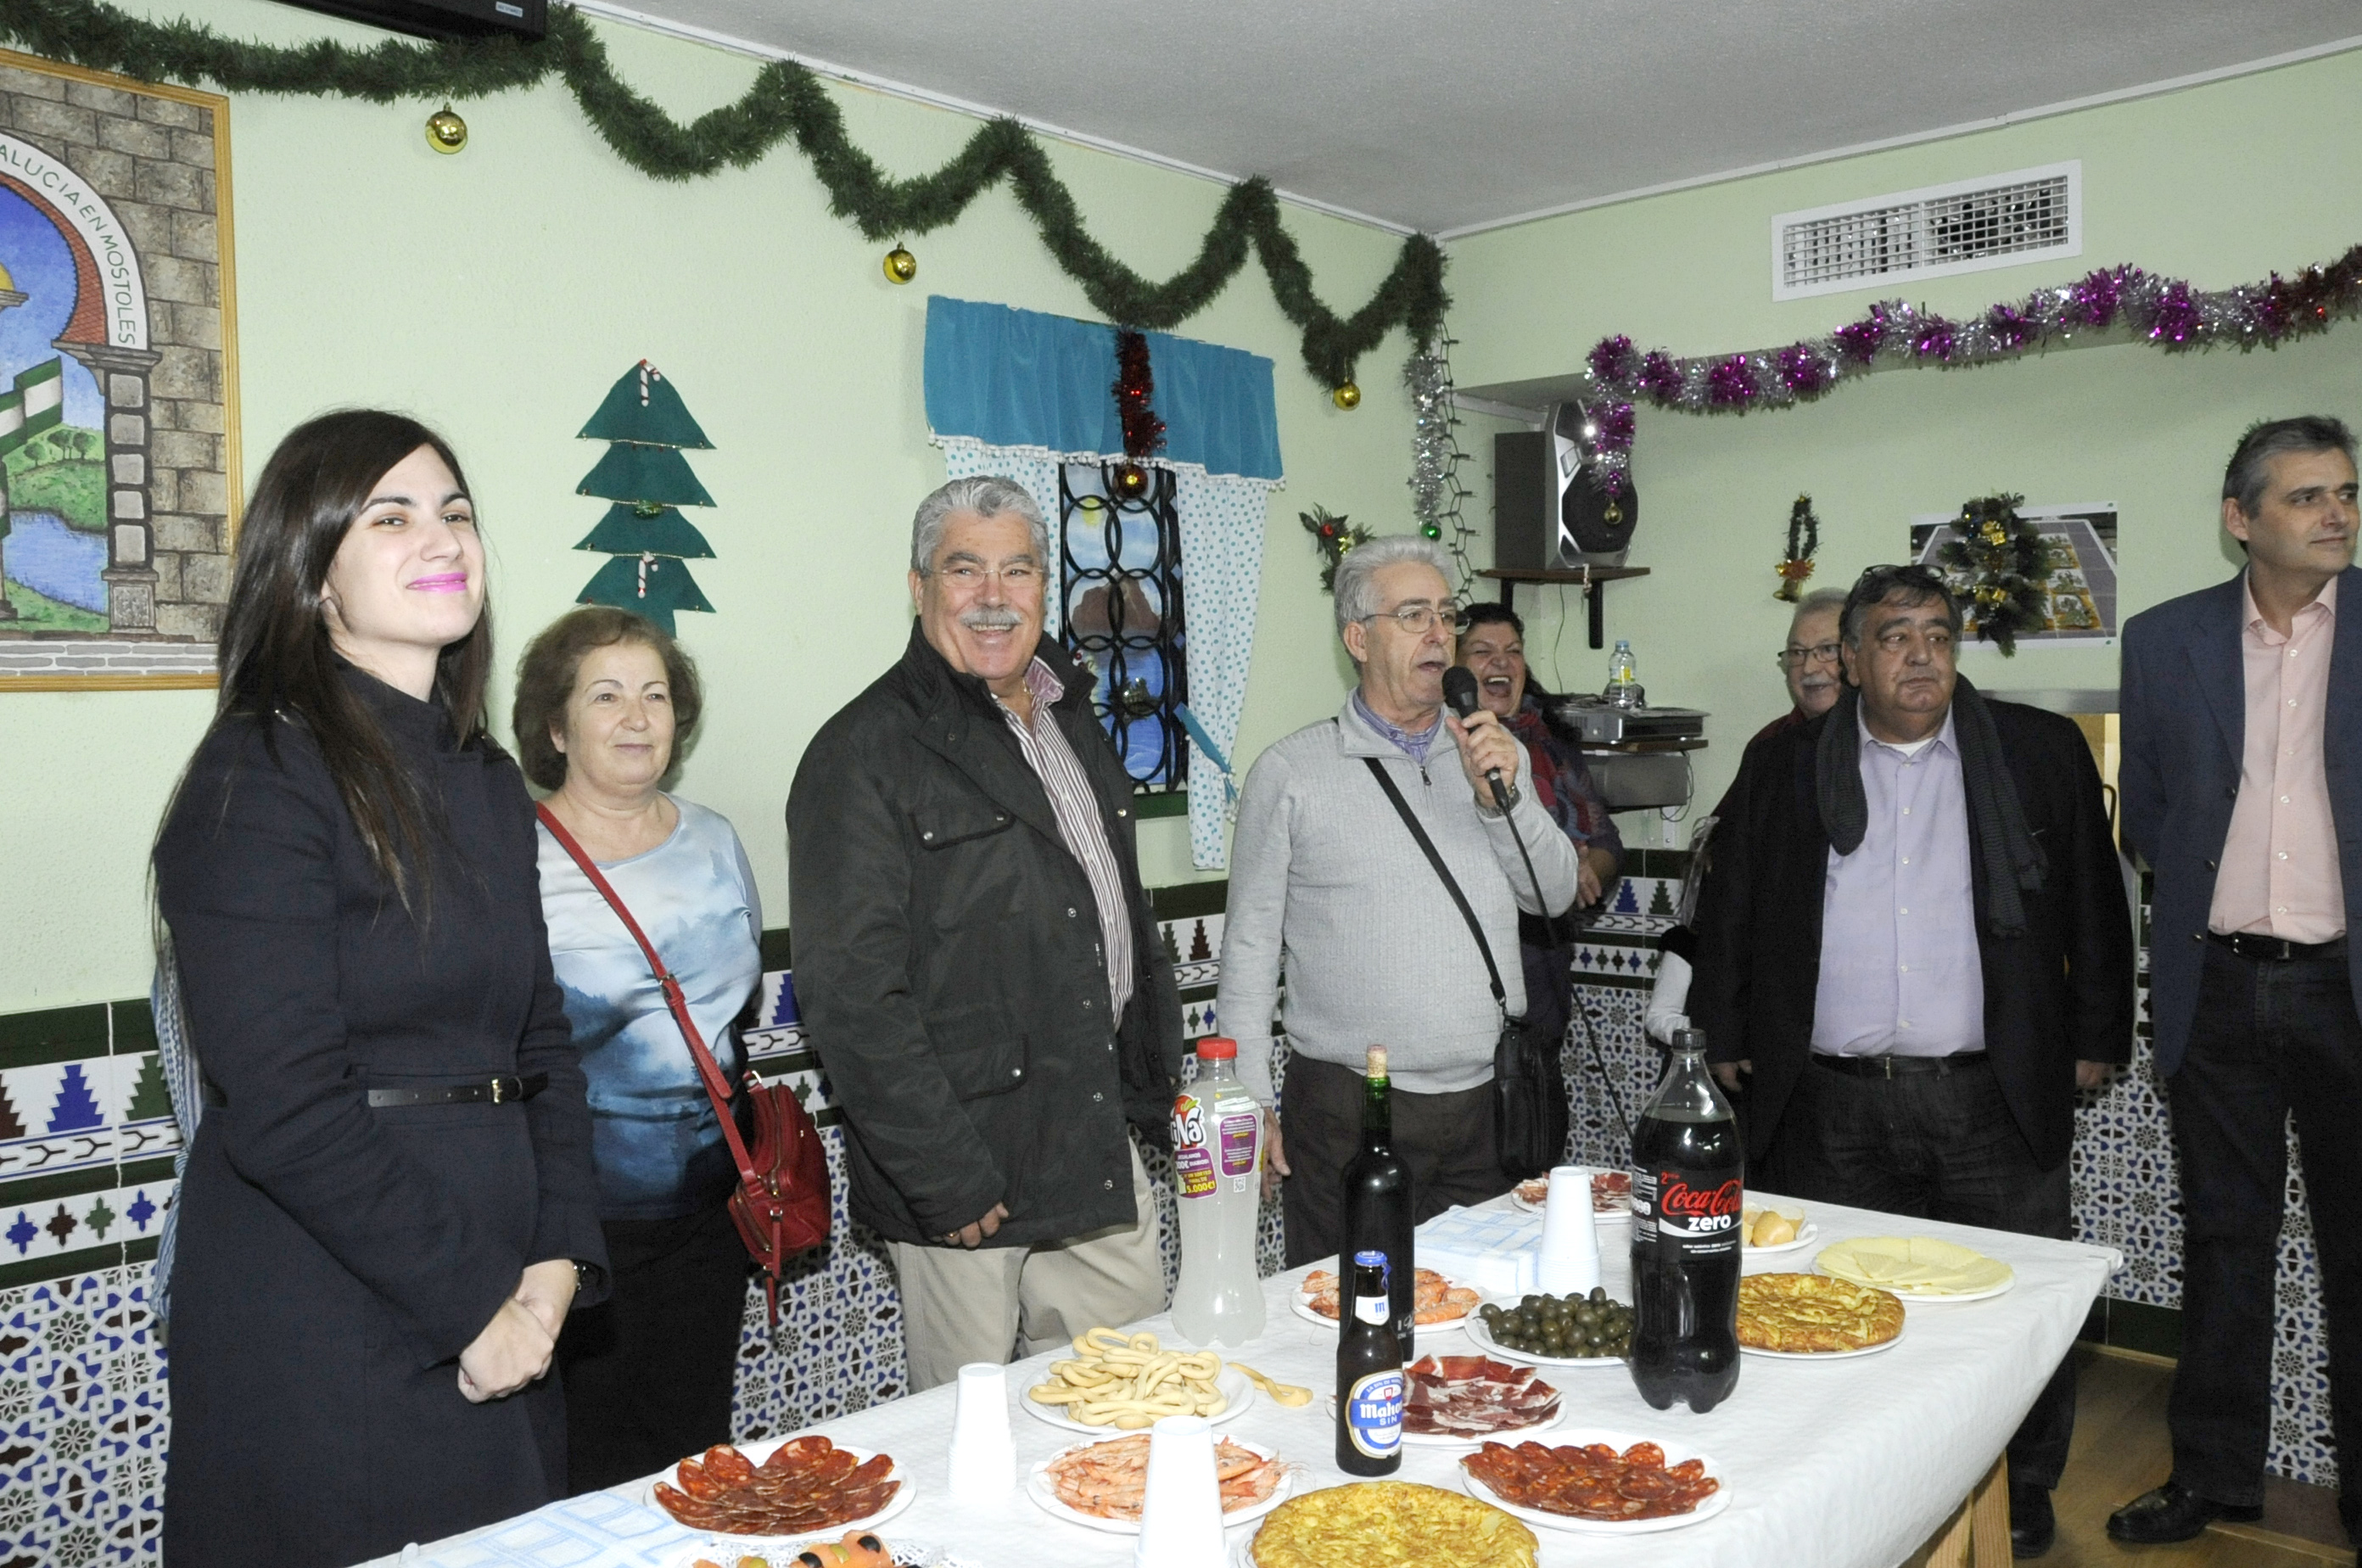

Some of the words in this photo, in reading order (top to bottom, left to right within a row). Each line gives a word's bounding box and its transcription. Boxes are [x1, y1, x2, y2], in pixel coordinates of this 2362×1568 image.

[79, 204, 108, 232] EN
[100, 234, 136, 345] MOSTOLES
[1688, 1215, 1732, 1231] zero
[1380, 1415, 1397, 1425] SIN
